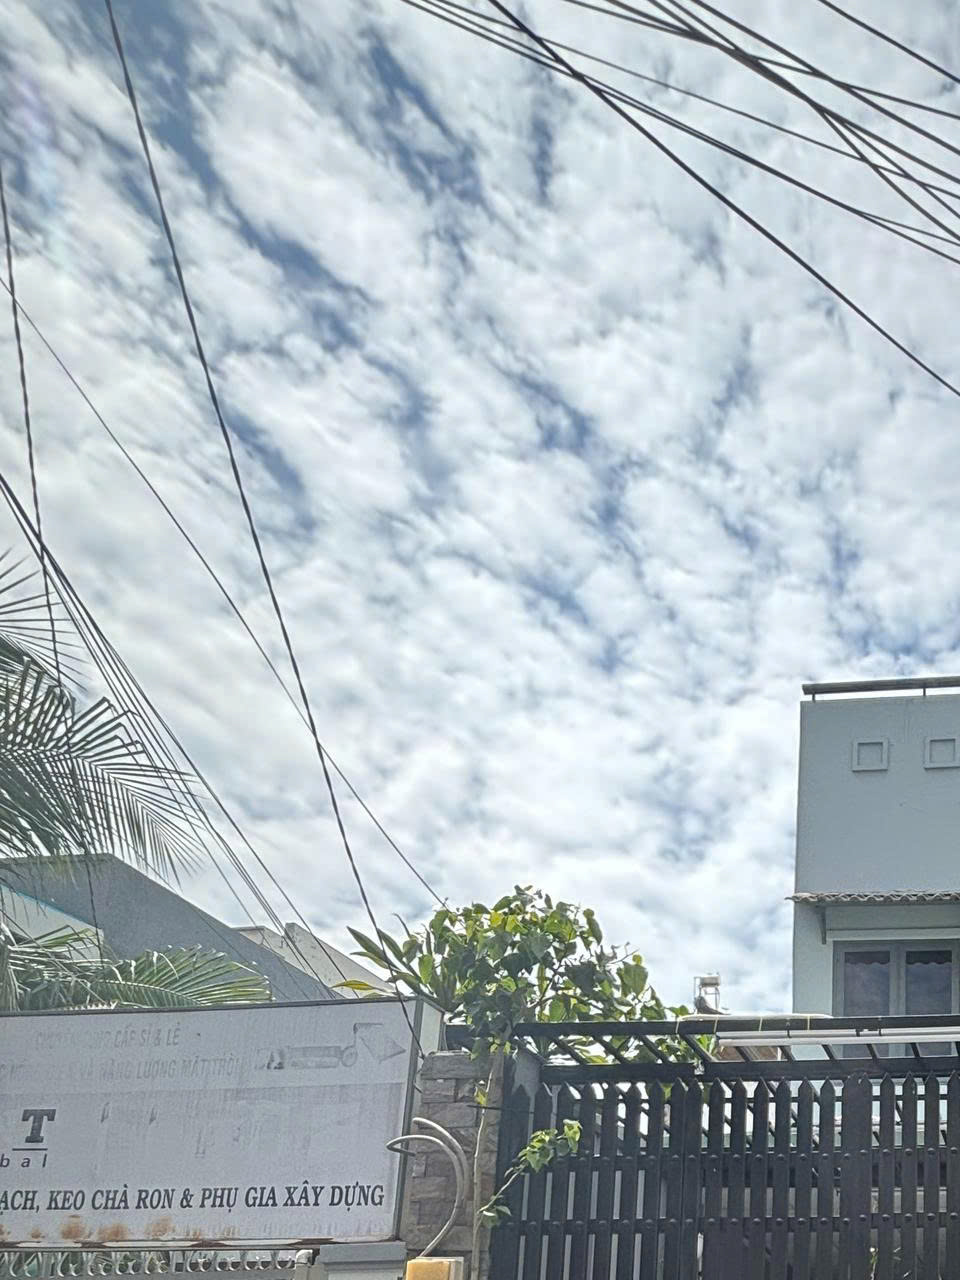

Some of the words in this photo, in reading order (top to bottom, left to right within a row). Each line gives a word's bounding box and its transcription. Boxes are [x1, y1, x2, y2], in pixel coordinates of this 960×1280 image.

[46, 1190, 86, 1211] KEO
[91, 1183, 130, 1210] CHÀ
[135, 1188, 175, 1209] RON
[179, 1188, 194, 1209] &
[199, 1187, 239, 1213] PHỤ
[244, 1186, 278, 1208] GIA
[282, 1179, 325, 1207] XÂY
[328, 1181, 385, 1212] DỰNG
